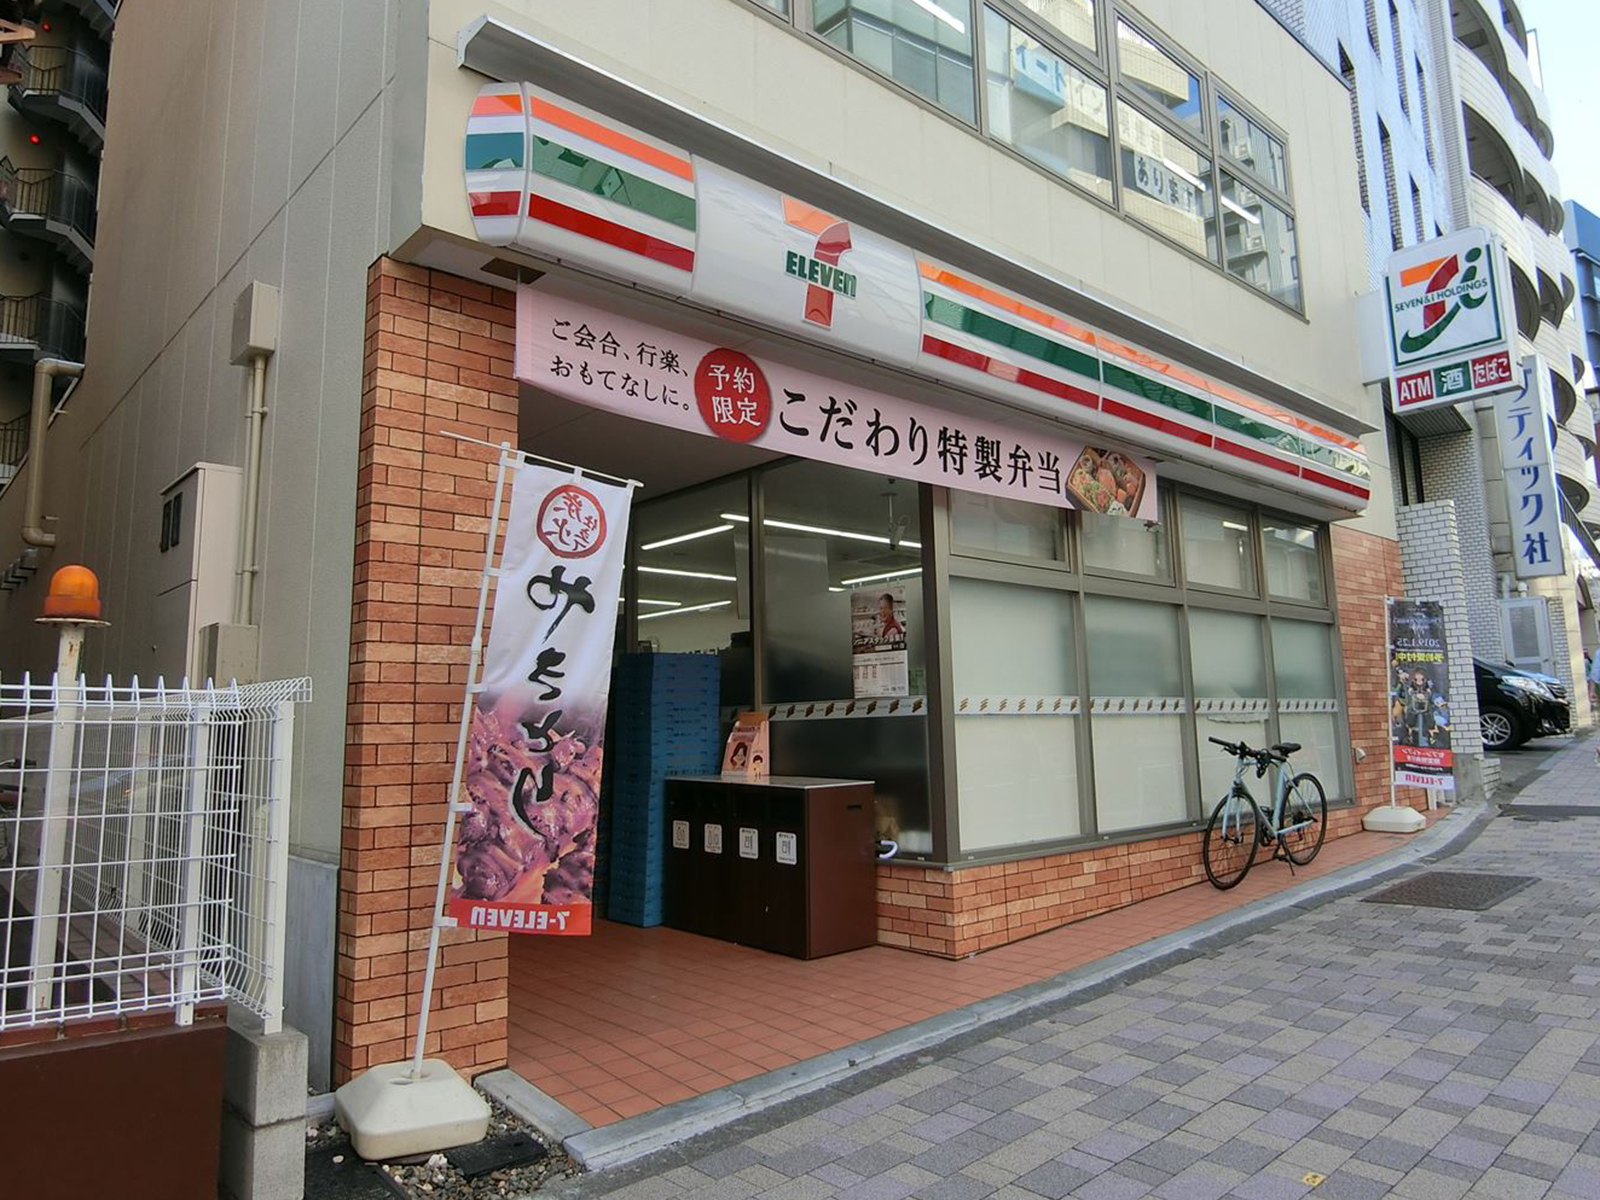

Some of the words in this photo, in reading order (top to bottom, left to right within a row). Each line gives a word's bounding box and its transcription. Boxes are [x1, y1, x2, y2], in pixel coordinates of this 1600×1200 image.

[1437, 278, 1488, 300] HOLDINGS
[551, 318, 689, 377] ご会合、行楽、
[550, 355, 690, 412] おもてなしに。
[708, 365, 755, 394] 予約
[1441, 367, 1464, 393] 酒
[1474, 358, 1510, 383] たばこ
[1401, 375, 1432, 401] ATM
[711, 396, 761, 427] 限定
[779, 388, 1061, 494] こだわり特製弁当
